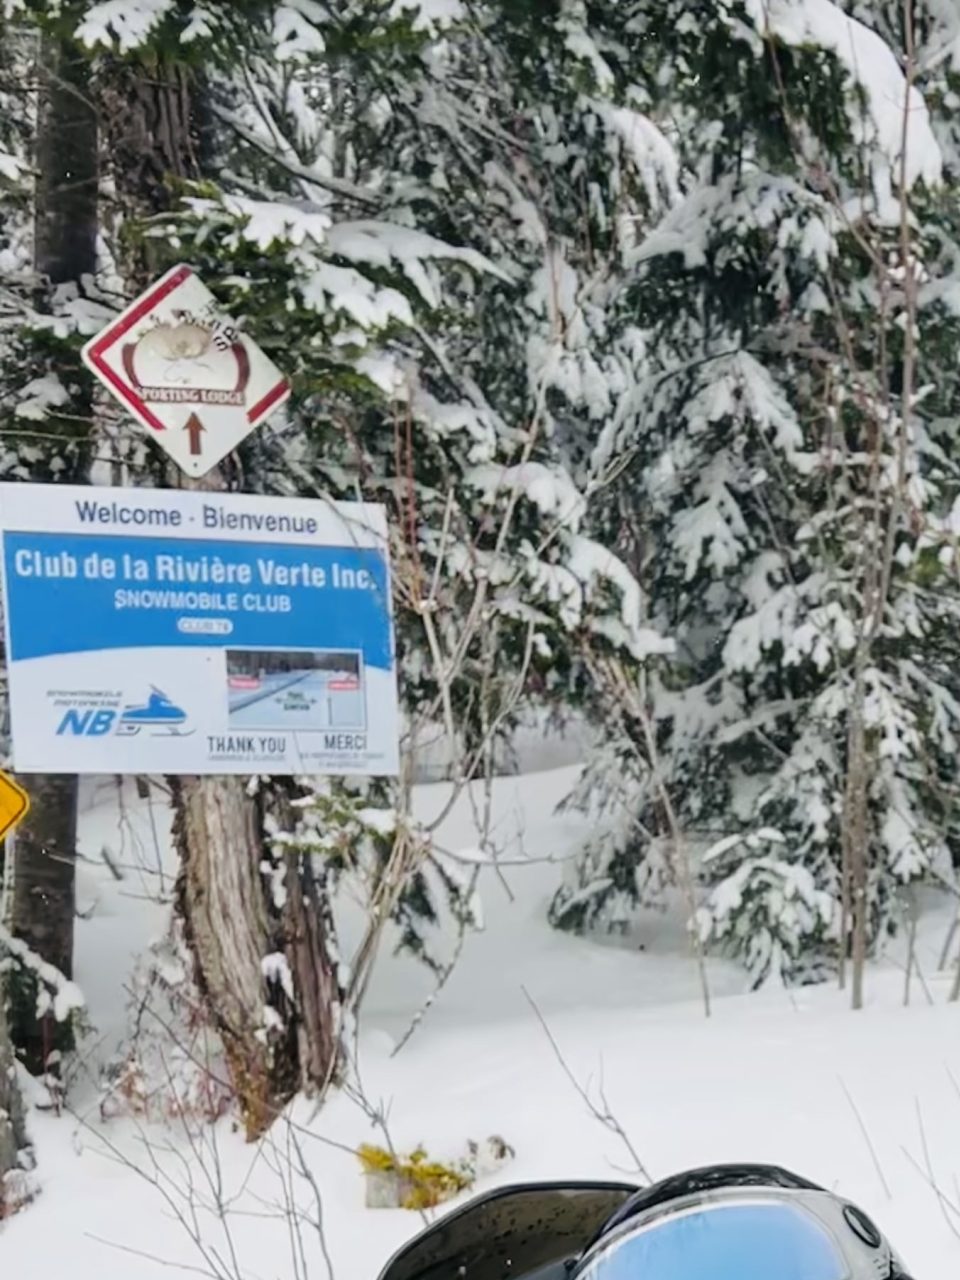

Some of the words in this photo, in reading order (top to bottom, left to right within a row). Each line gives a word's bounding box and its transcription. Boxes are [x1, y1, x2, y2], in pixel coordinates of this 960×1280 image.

[75, 501, 182, 526] Welcome
[203, 504, 318, 534] Bienvenue
[15, 549, 77, 578] Club
[84, 552, 116, 579] de
[123, 553, 149, 581] la
[156, 555, 251, 585] Rivière
[257, 559, 326, 588] Verte
[331, 562, 377, 591] Inc.
[114, 588, 238, 611] SNOWMOBILE
[242, 594, 292, 612] CLUB
[56, 708, 117, 737] NB
[207, 735, 256, 752] THANK
[260, 737, 287, 754] YOU
[324, 733, 367, 751] MERCI
